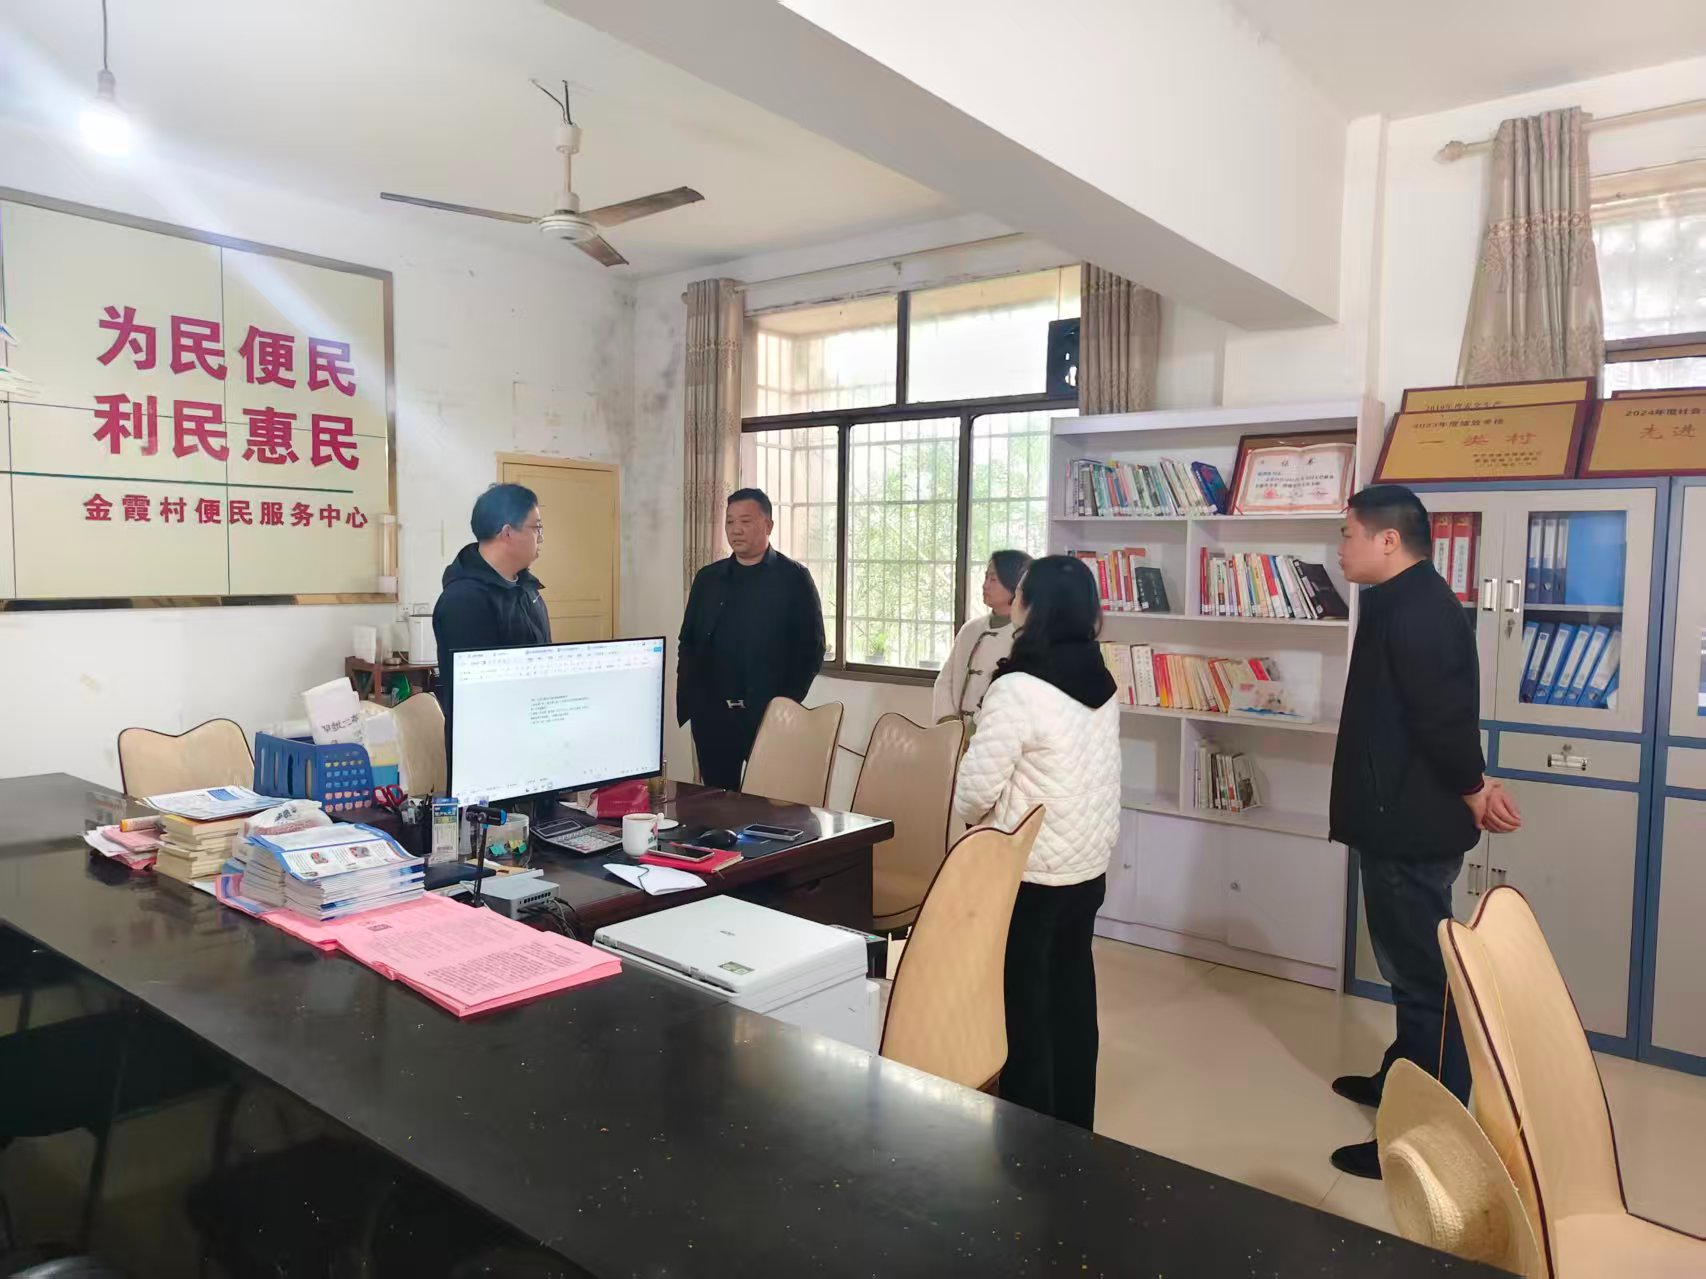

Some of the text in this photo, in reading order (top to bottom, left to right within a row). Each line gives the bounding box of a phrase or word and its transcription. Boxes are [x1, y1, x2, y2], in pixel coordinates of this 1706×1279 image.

[96, 305, 357, 397] 为民便民
[93, 393, 360, 471] 利民惠民
[82, 493, 369, 529] 金霞村便民服务中心
